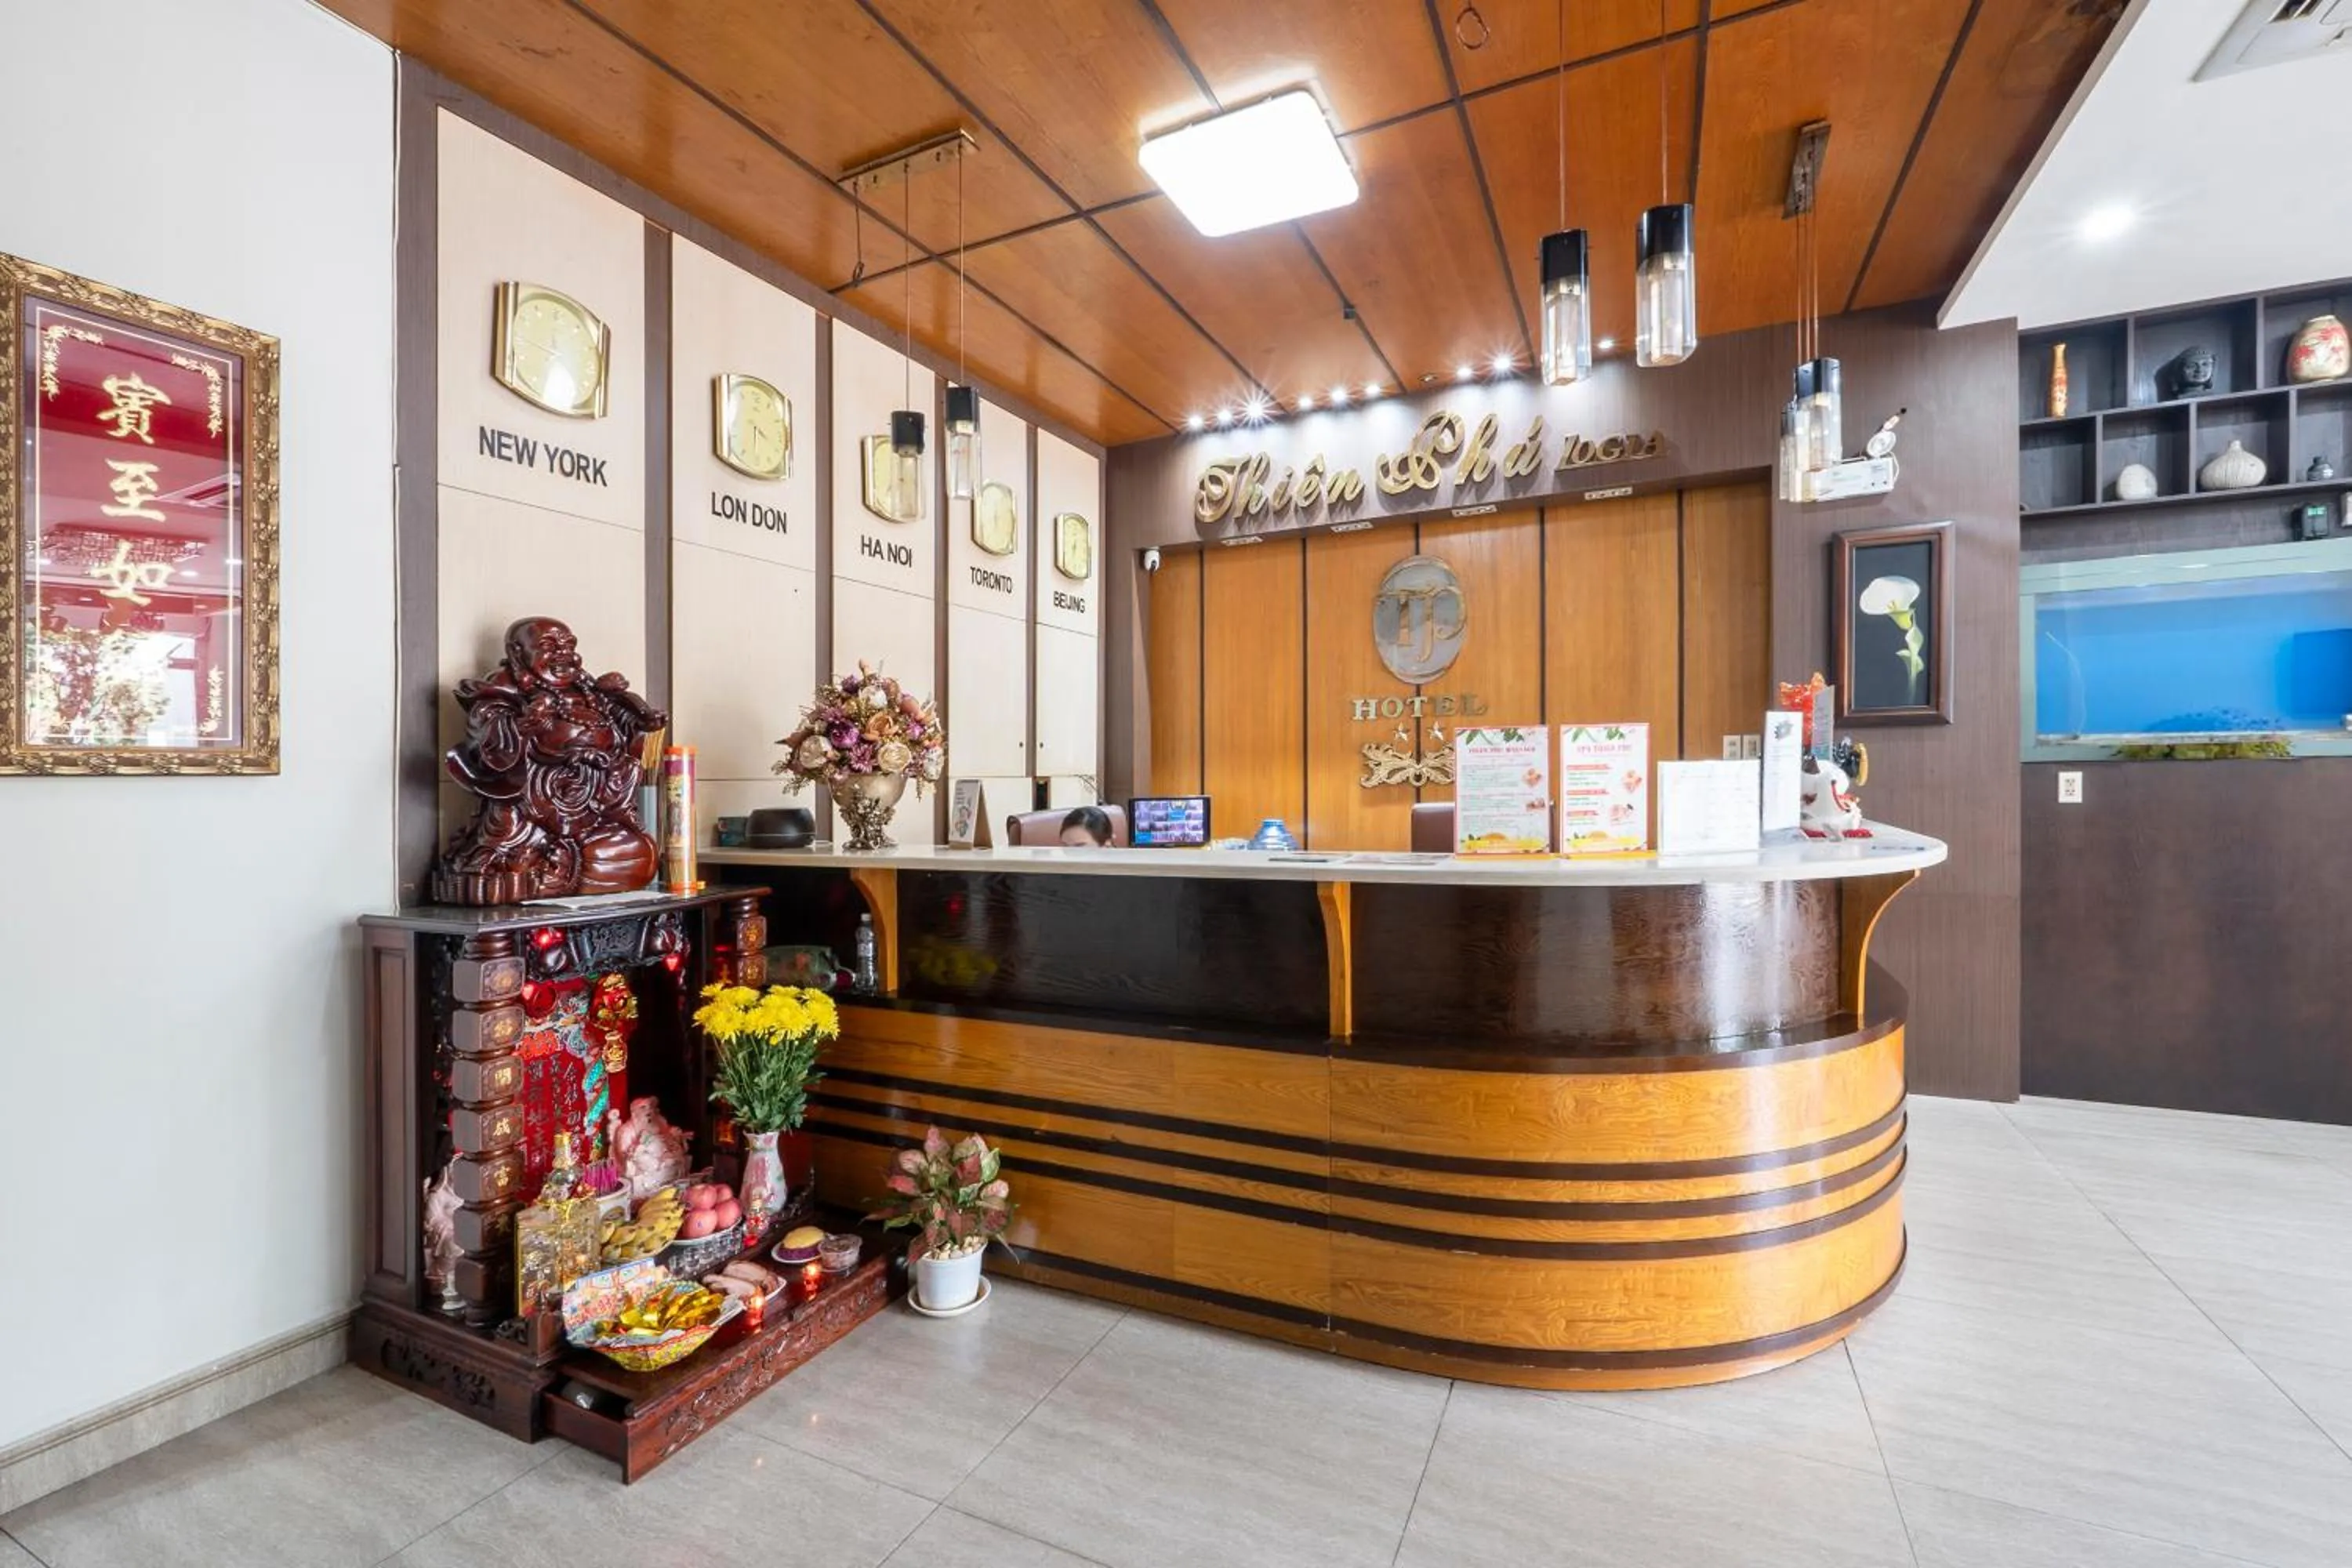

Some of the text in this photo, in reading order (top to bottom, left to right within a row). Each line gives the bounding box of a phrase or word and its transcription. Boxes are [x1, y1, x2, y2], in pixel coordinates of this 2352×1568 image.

[479, 425, 608, 487] NEW YORK
[1195, 452, 1365, 522] Thiên
[1376, 410, 1544, 495] Phú
[861, 535, 913, 568] HA NOI
[970, 565, 1012, 593] TORONTO
[1352, 692, 1488, 720] HOTEL
